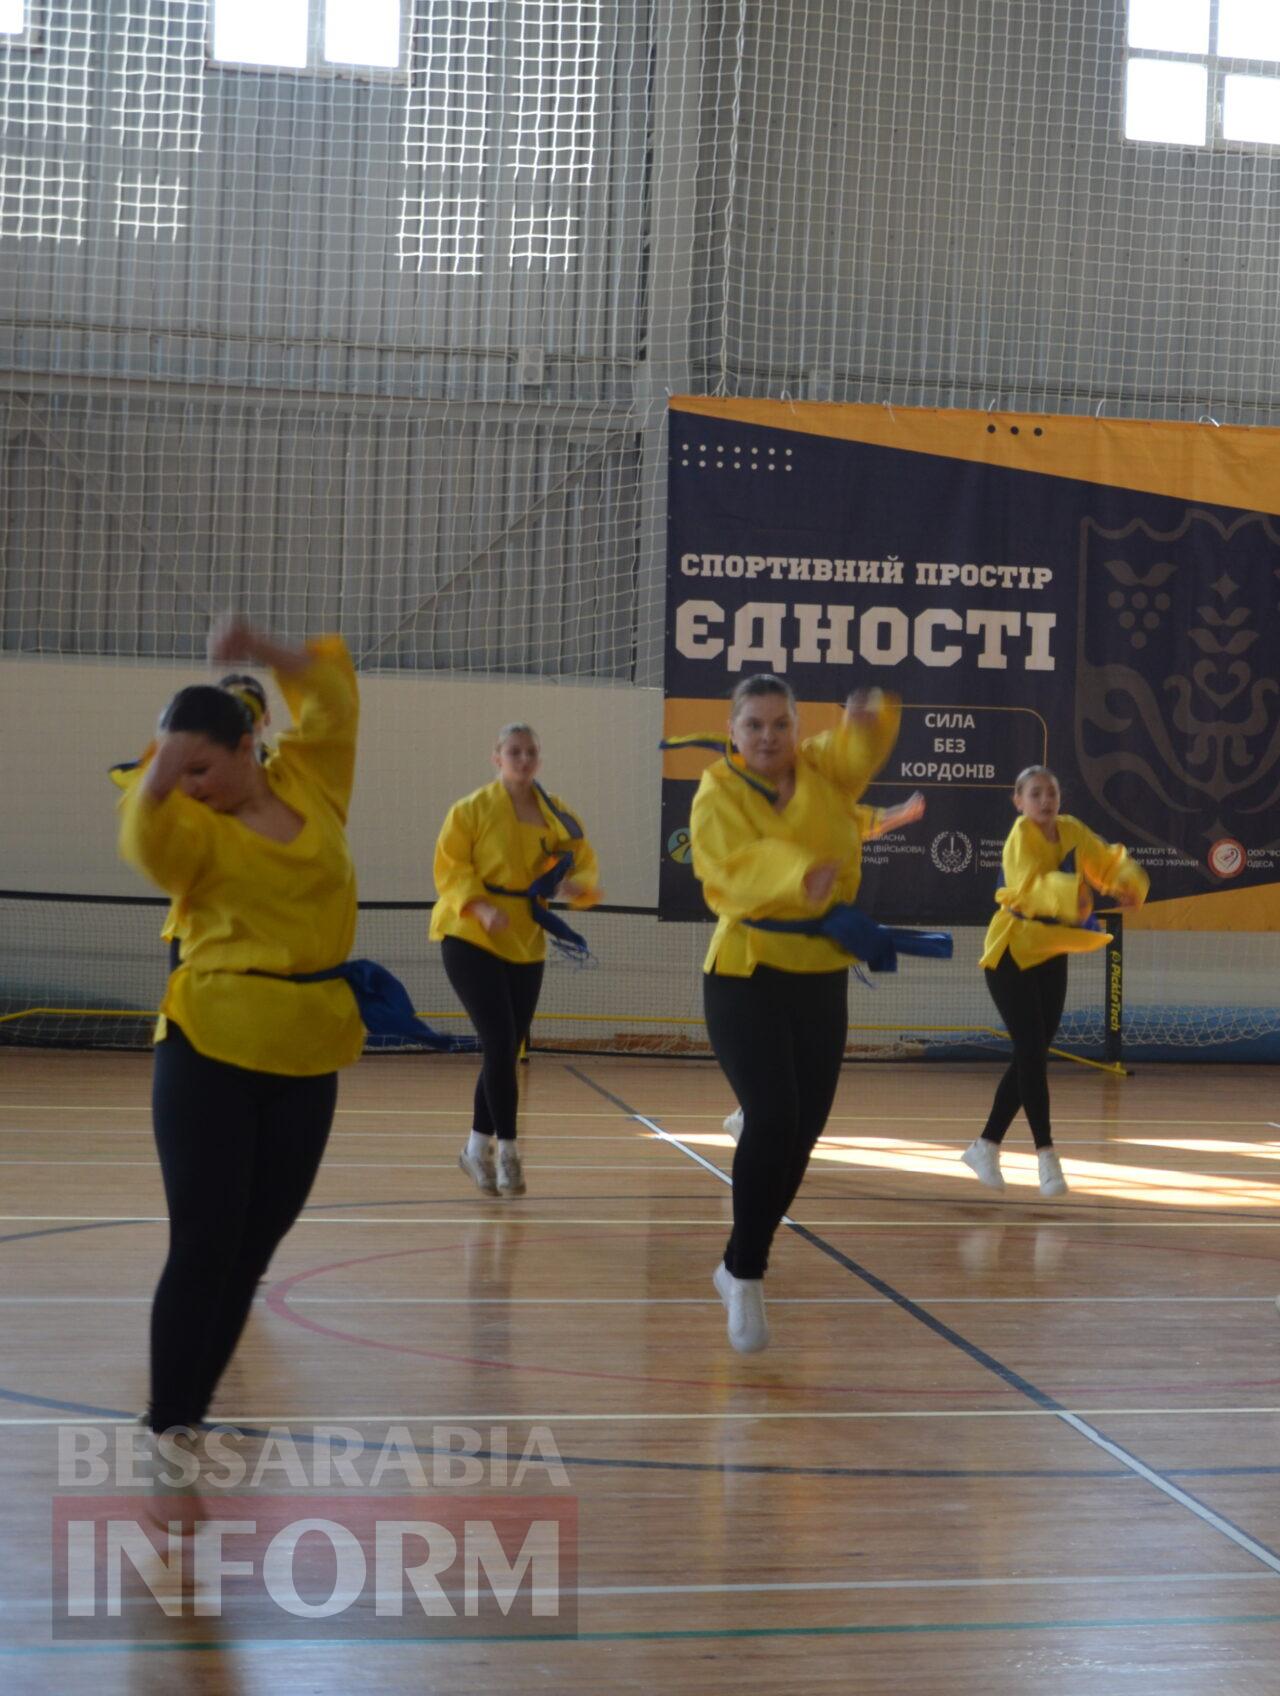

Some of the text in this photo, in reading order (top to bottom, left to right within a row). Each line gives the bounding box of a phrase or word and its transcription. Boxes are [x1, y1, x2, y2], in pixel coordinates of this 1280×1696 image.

[681, 553, 1053, 590] СПОРТИВНИЙ ПРОСТІР
[675, 599, 1056, 673] ЄДНОСТІ
[924, 712, 976, 729] СИЛА
[933, 737, 966, 753] БЕЗ
[901, 762, 995, 781] КОРДОНІВ
